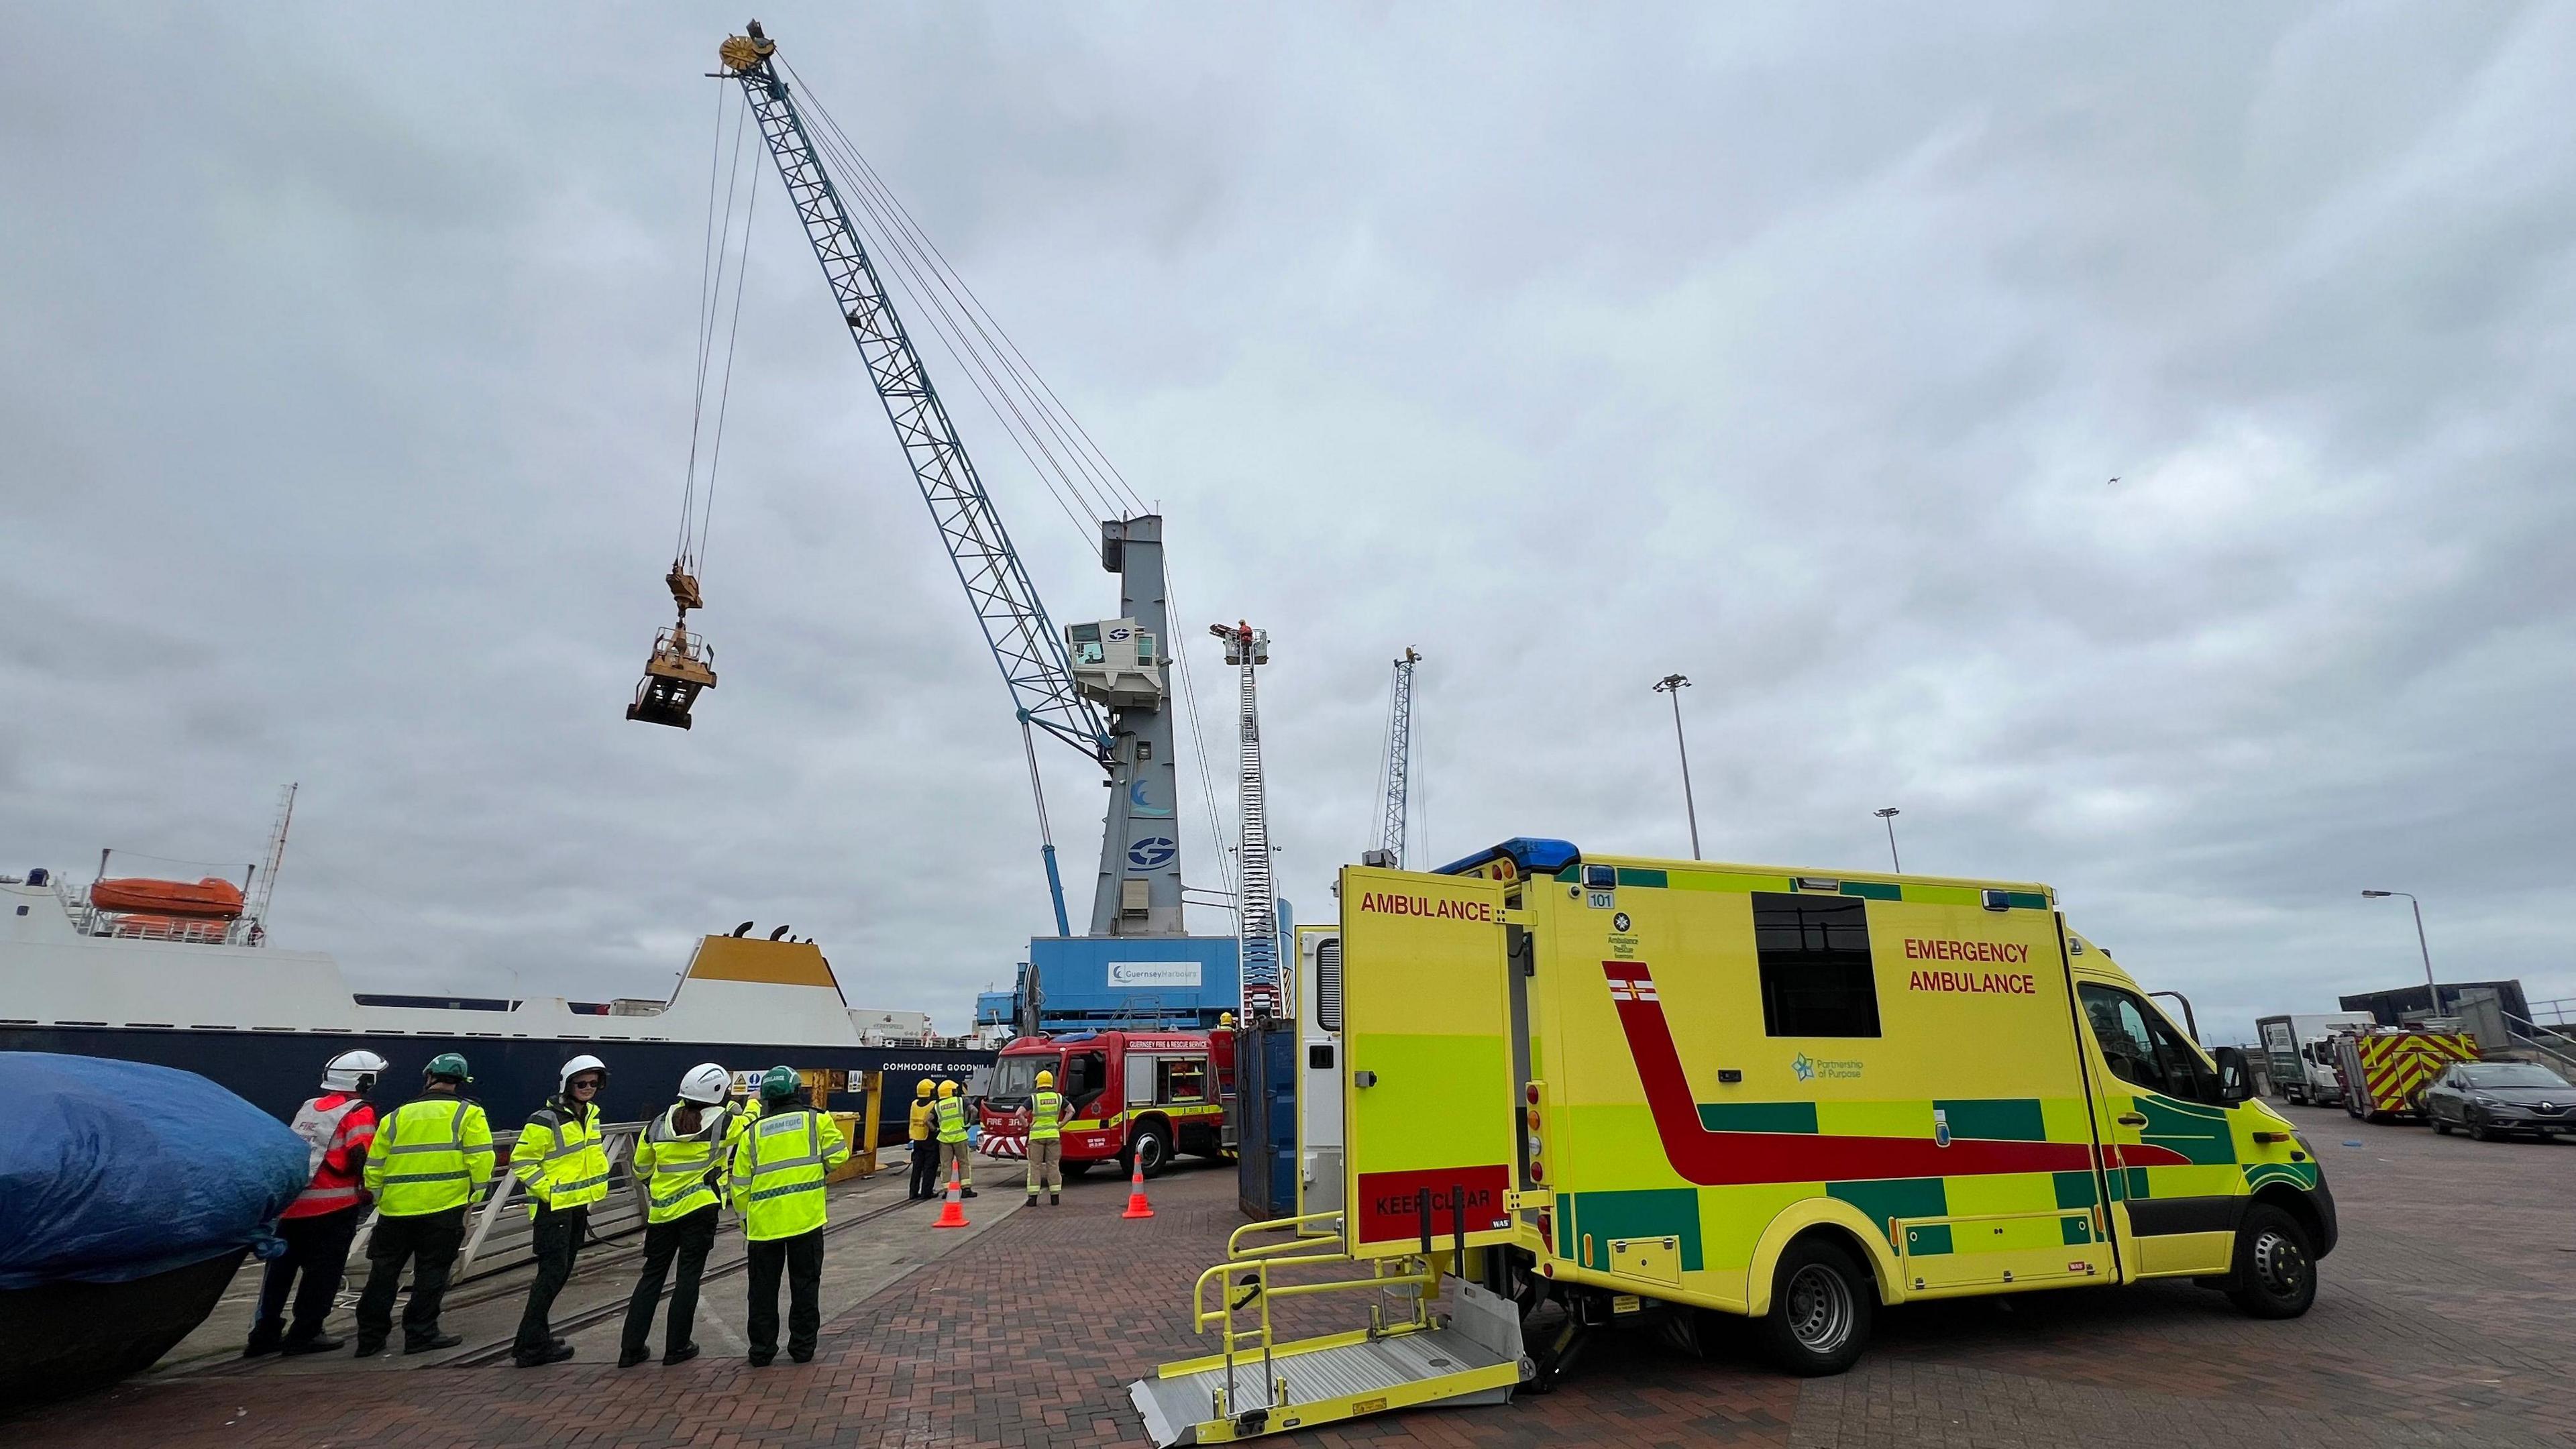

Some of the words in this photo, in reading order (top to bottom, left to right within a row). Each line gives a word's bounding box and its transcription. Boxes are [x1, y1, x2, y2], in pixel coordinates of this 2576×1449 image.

[1360, 892, 1491, 922] AMBULANCE
[1591, 894, 1611, 907] 101
[1904, 938, 2029, 963] EMERGENCY
[1909, 971, 2036, 994] AMBULANCE
[883, 1063, 943, 1071] COMMODORE
[1817, 1060, 1864, 1069] Partnership
[1829, 1069, 1861, 1079] Purpose
[299, 1121, 319, 1132] FIRE
[763, 1118, 801, 1132] PARAMEDIC
[987, 1118, 1002, 1126] FIRE
[1376, 1194, 1421, 1216] KEEP
[1432, 1189, 1491, 1212] CLAR
[1492, 1220, 1509, 1228] WAS
